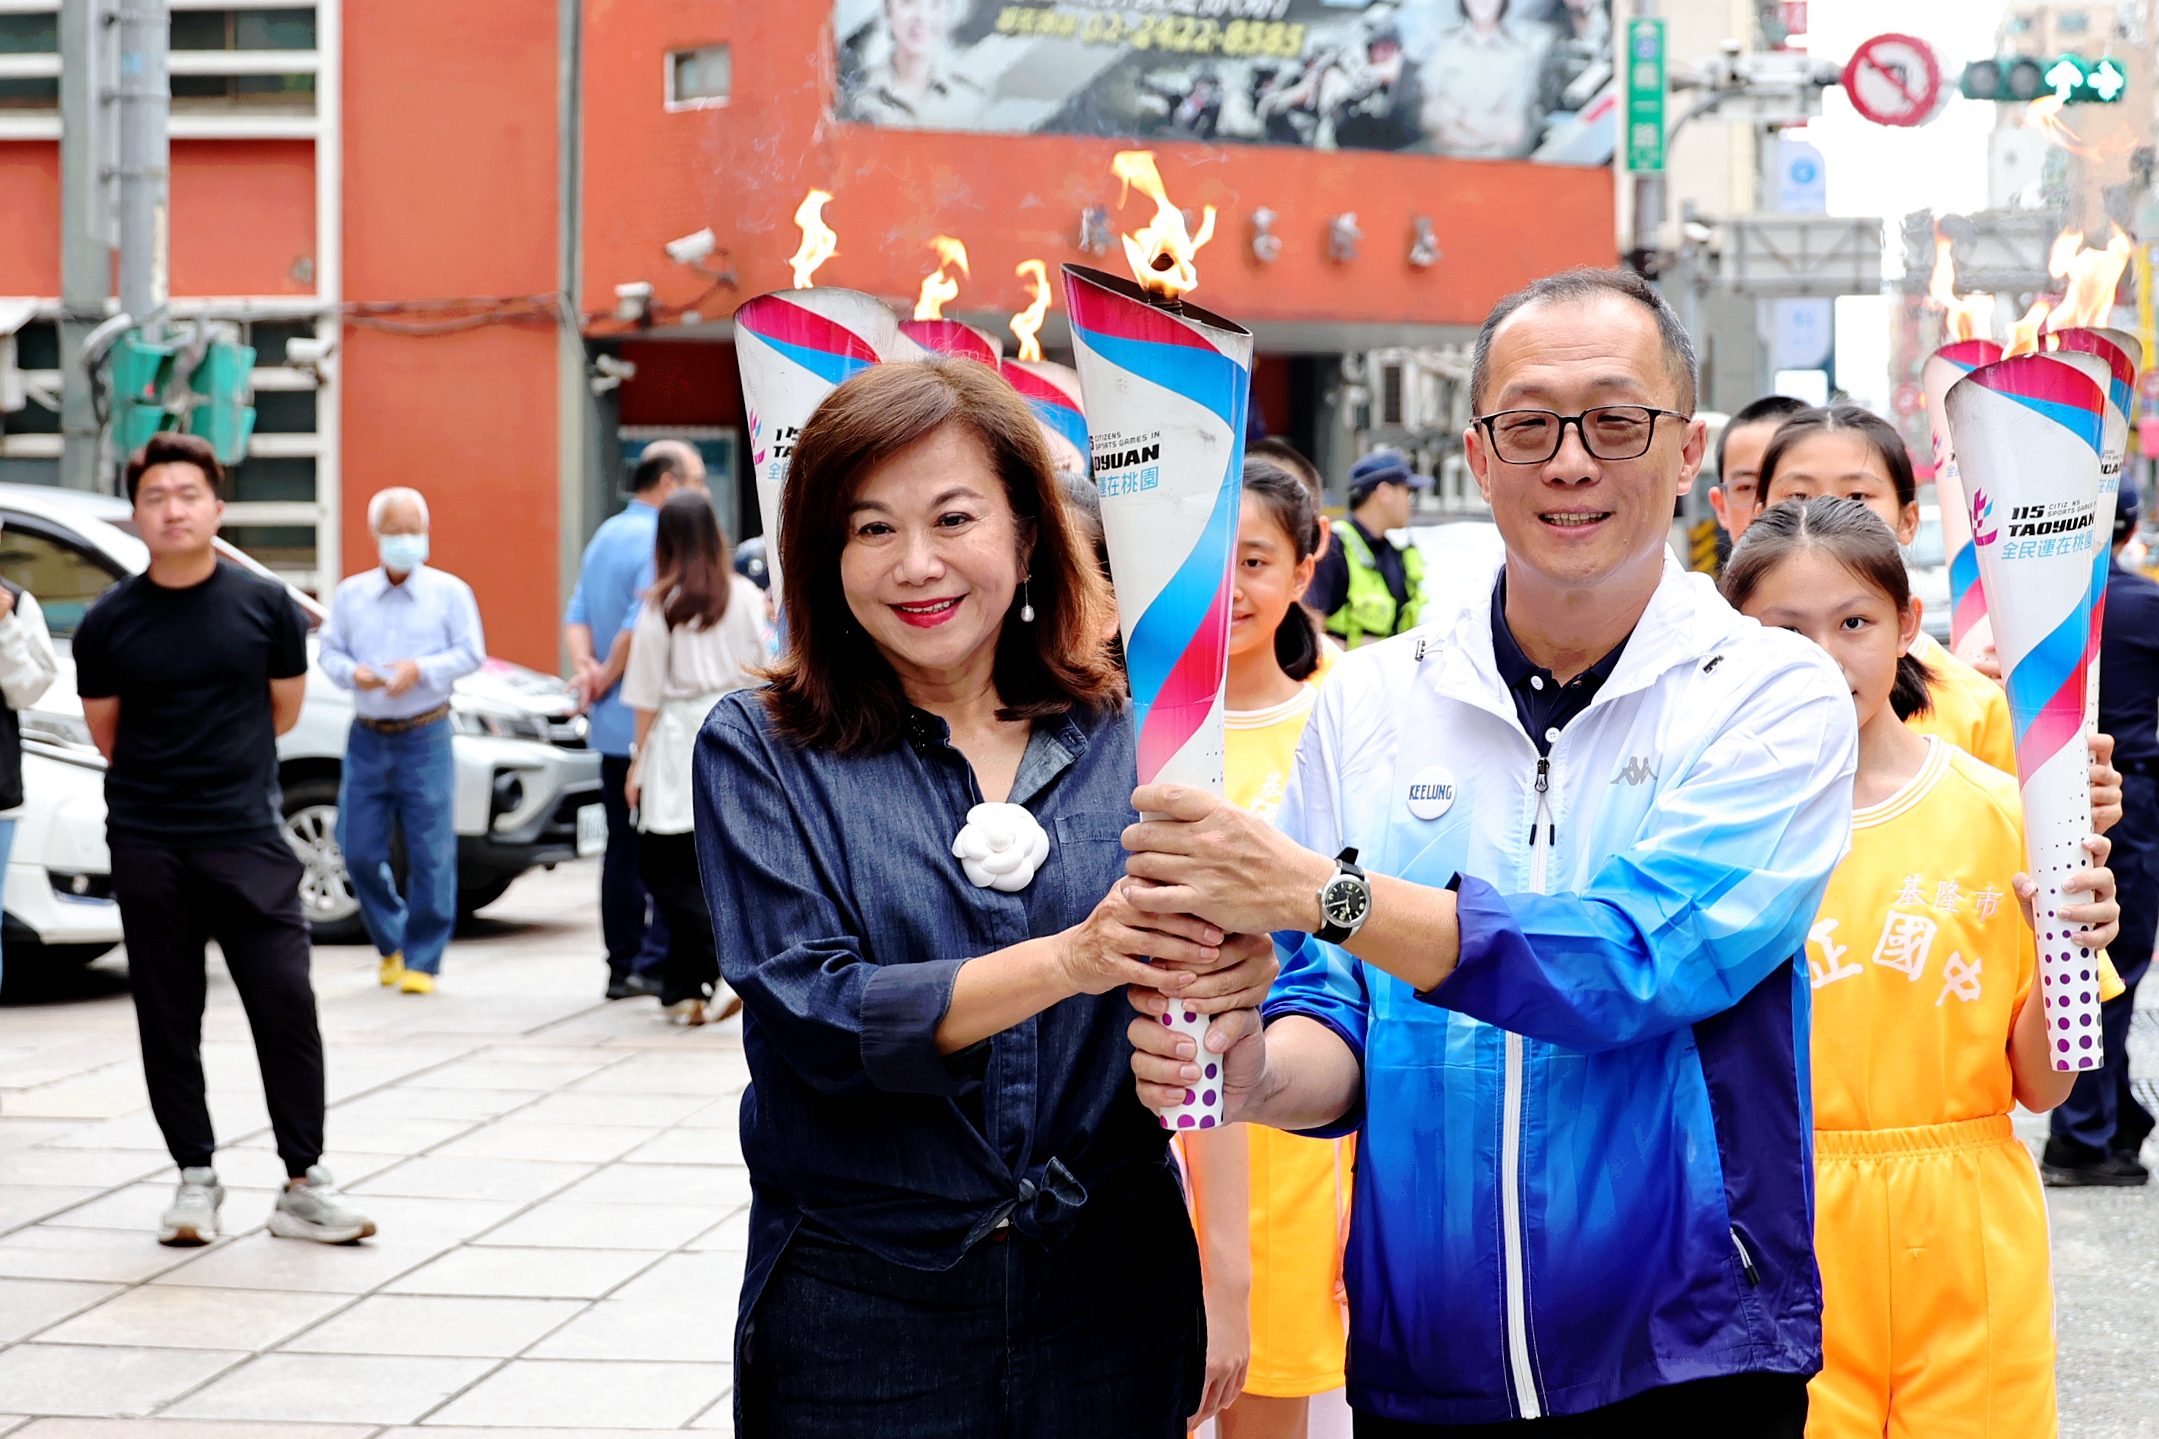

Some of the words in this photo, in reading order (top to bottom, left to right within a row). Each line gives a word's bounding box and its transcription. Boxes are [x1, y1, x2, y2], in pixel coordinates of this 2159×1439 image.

[1095, 431, 1121, 442] CITIZENS
[1119, 433, 1147, 447] GAMES
[1150, 430, 1160, 439] IN
[1094, 443, 1160, 471] OYUAN
[2011, 505, 2045, 520] 115
[2048, 499, 2081, 510] CITIZNS
[2047, 508, 2075, 518] SPORTS
[2008, 511, 2095, 537] TAOYUAN
[2001, 529, 2093, 560] 全民運在桃園
[1408, 784, 1453, 801] KEELUNG
[1894, 873, 2005, 924] 基隆市
